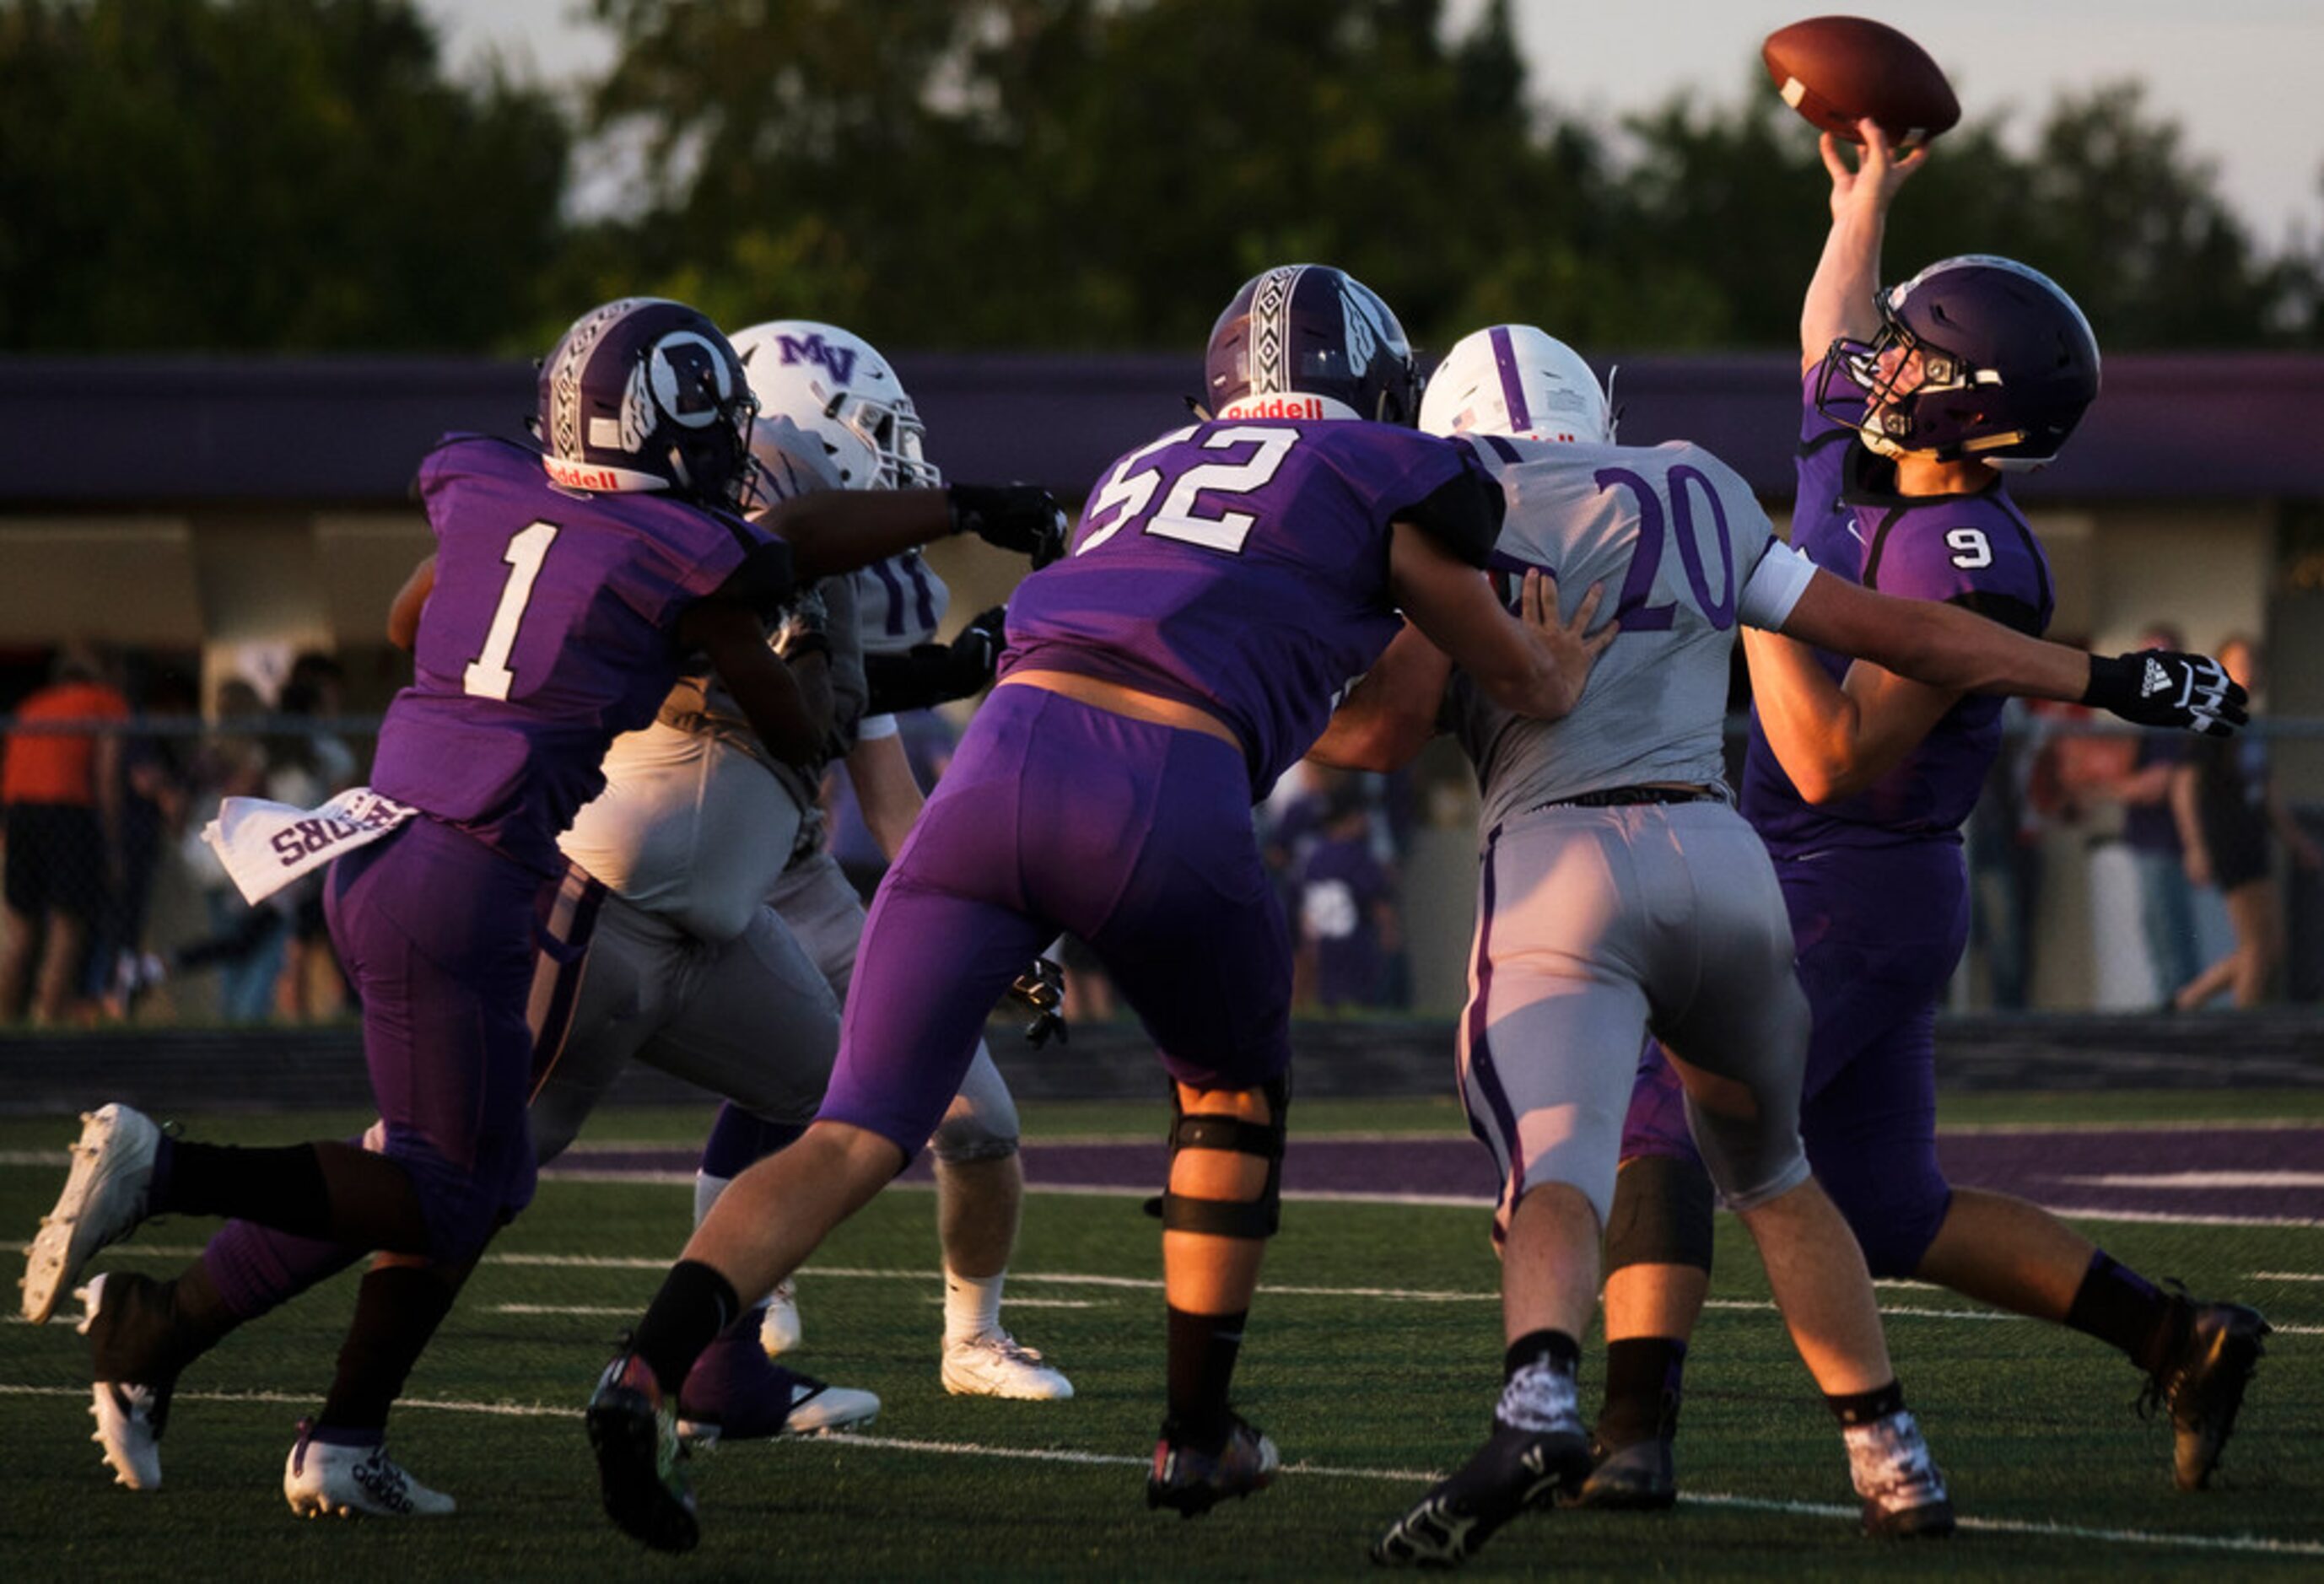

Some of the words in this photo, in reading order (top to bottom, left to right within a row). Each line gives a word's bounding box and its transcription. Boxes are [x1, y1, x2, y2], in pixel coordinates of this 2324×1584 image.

[774, 333, 857, 388] MV
[544, 460, 619, 491] ddell
[1075, 423, 1302, 557] 52
[1593, 465, 1735, 631] 20
[1944, 526, 1993, 569] 9
[461, 518, 562, 703] 1
